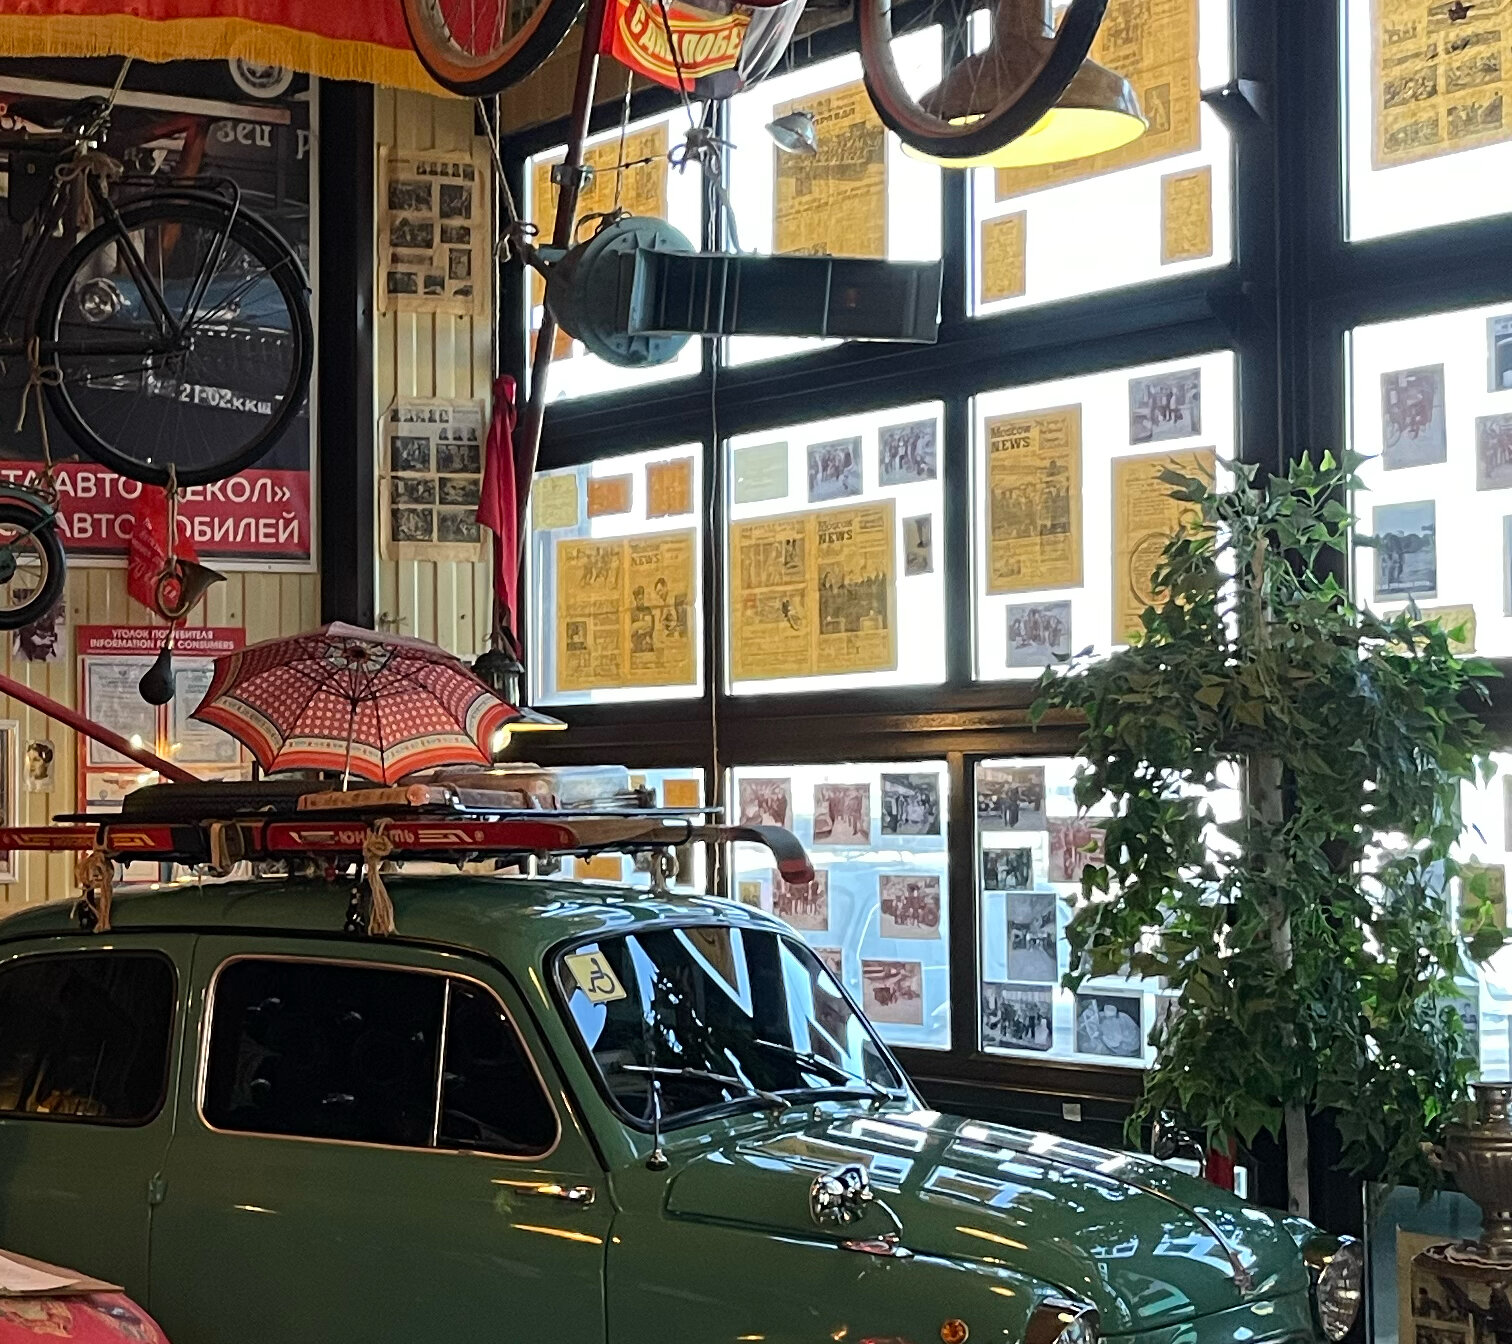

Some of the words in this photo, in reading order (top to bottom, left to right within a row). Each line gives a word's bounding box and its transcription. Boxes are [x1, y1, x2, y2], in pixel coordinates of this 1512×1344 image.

[681, 26, 743, 64] ПОБЕ
[55, 472, 291, 505] АВТОЕКОЛ»
[55, 510, 300, 545] АВТООБИЛЕЙ
[90, 639, 154, 649] INFORMATION
[178, 641, 234, 650] CONSUMERS
[112, 629, 149, 639] УГОЛОК
[152, 629, 214, 640] ПОЕБИТЕЛЯ
